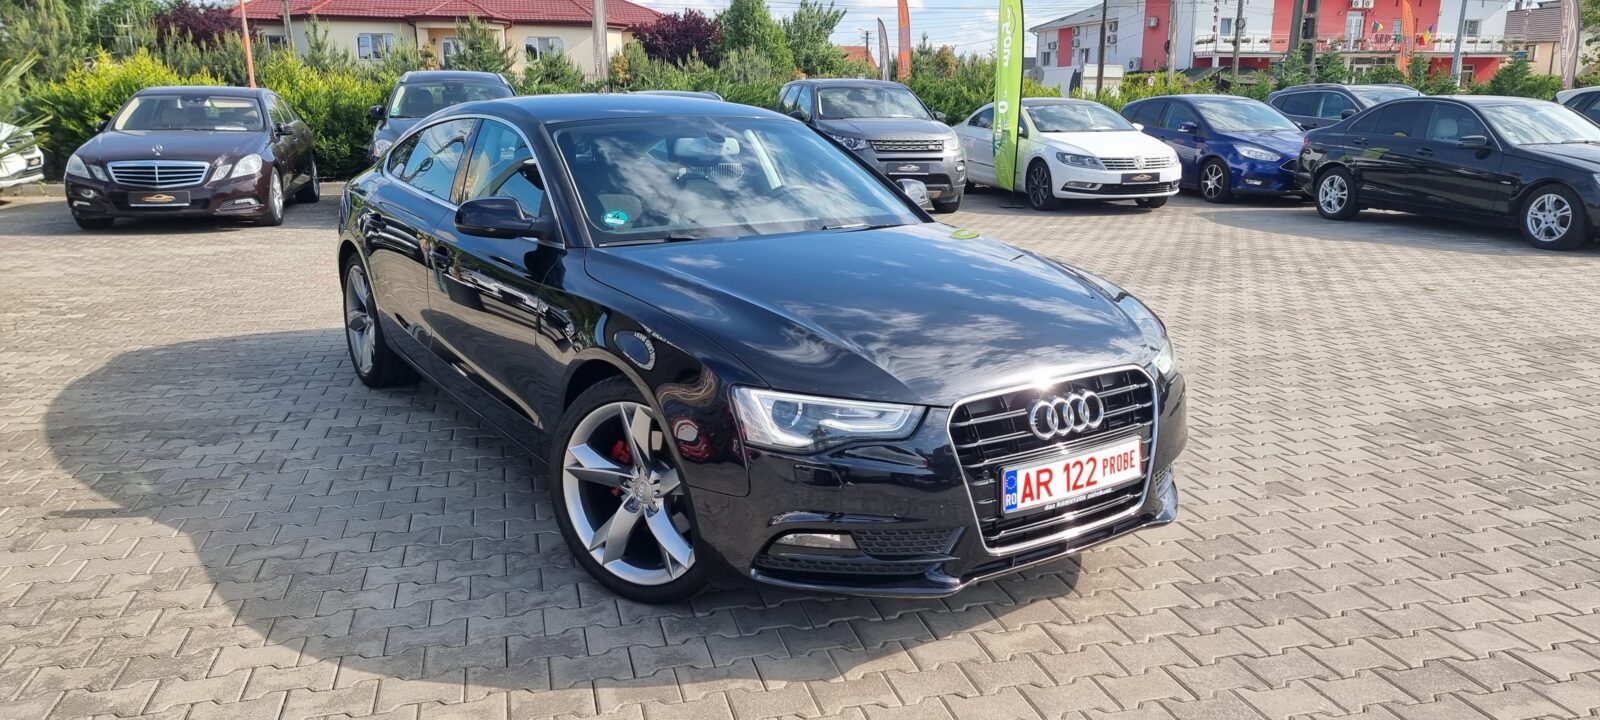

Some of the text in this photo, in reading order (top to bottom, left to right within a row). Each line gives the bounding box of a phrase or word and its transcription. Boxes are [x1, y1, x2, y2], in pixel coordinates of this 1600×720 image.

[1021, 450, 1135, 503] AR 122 PROBE
[1006, 493, 1017, 507] RO
